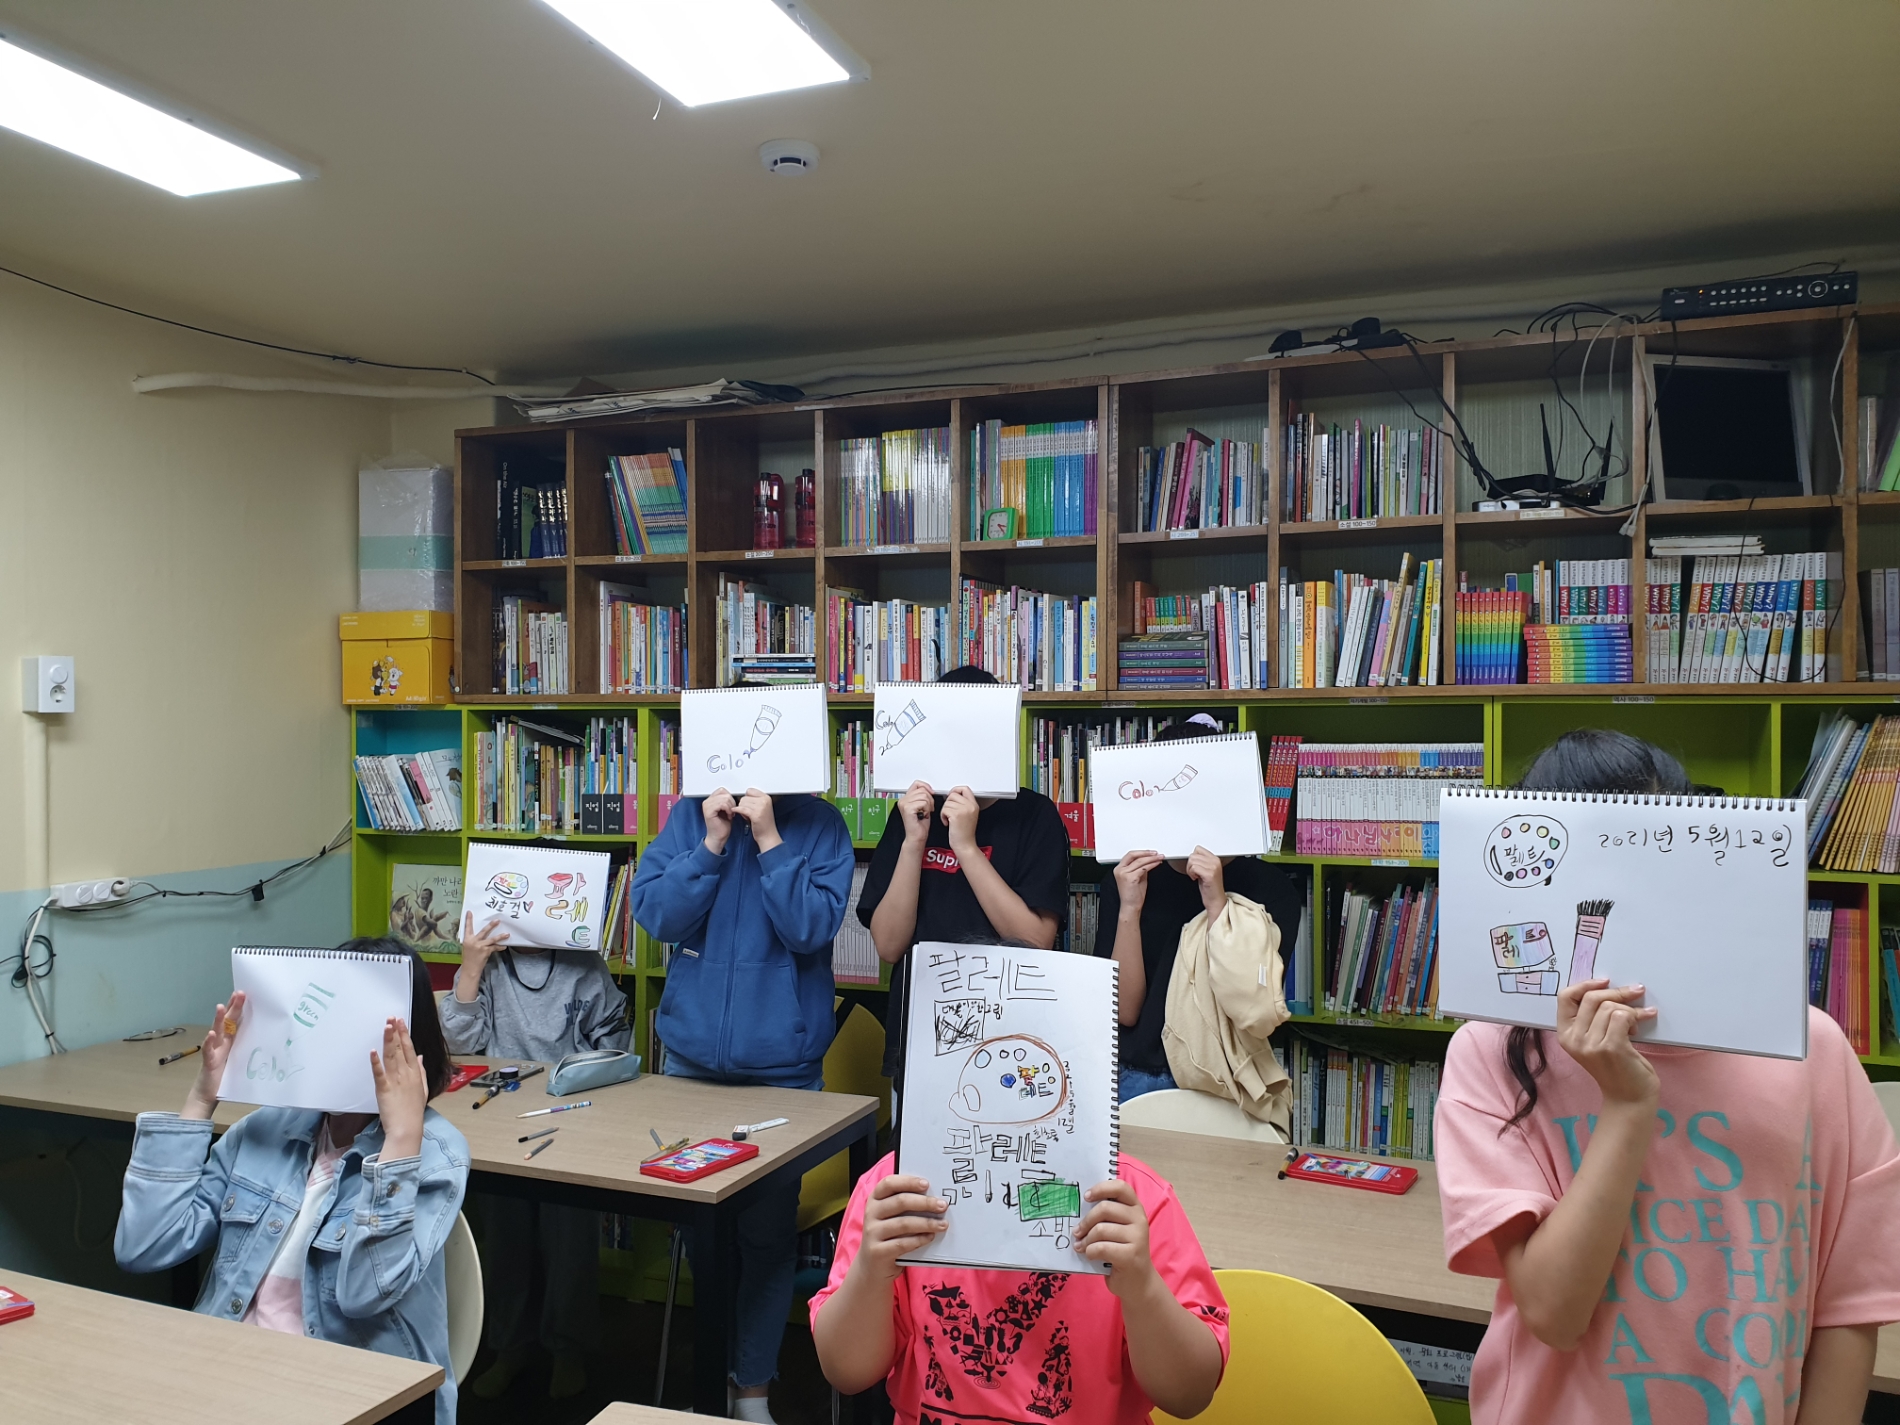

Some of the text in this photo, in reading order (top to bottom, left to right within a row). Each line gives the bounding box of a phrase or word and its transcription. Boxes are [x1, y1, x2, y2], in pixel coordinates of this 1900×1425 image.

[1118, 780, 1161, 800] Color
[1598, 824, 1674, 853] 2021년
[297, 1001, 320, 1021] green
[1603, 1312, 1655, 1365] A
